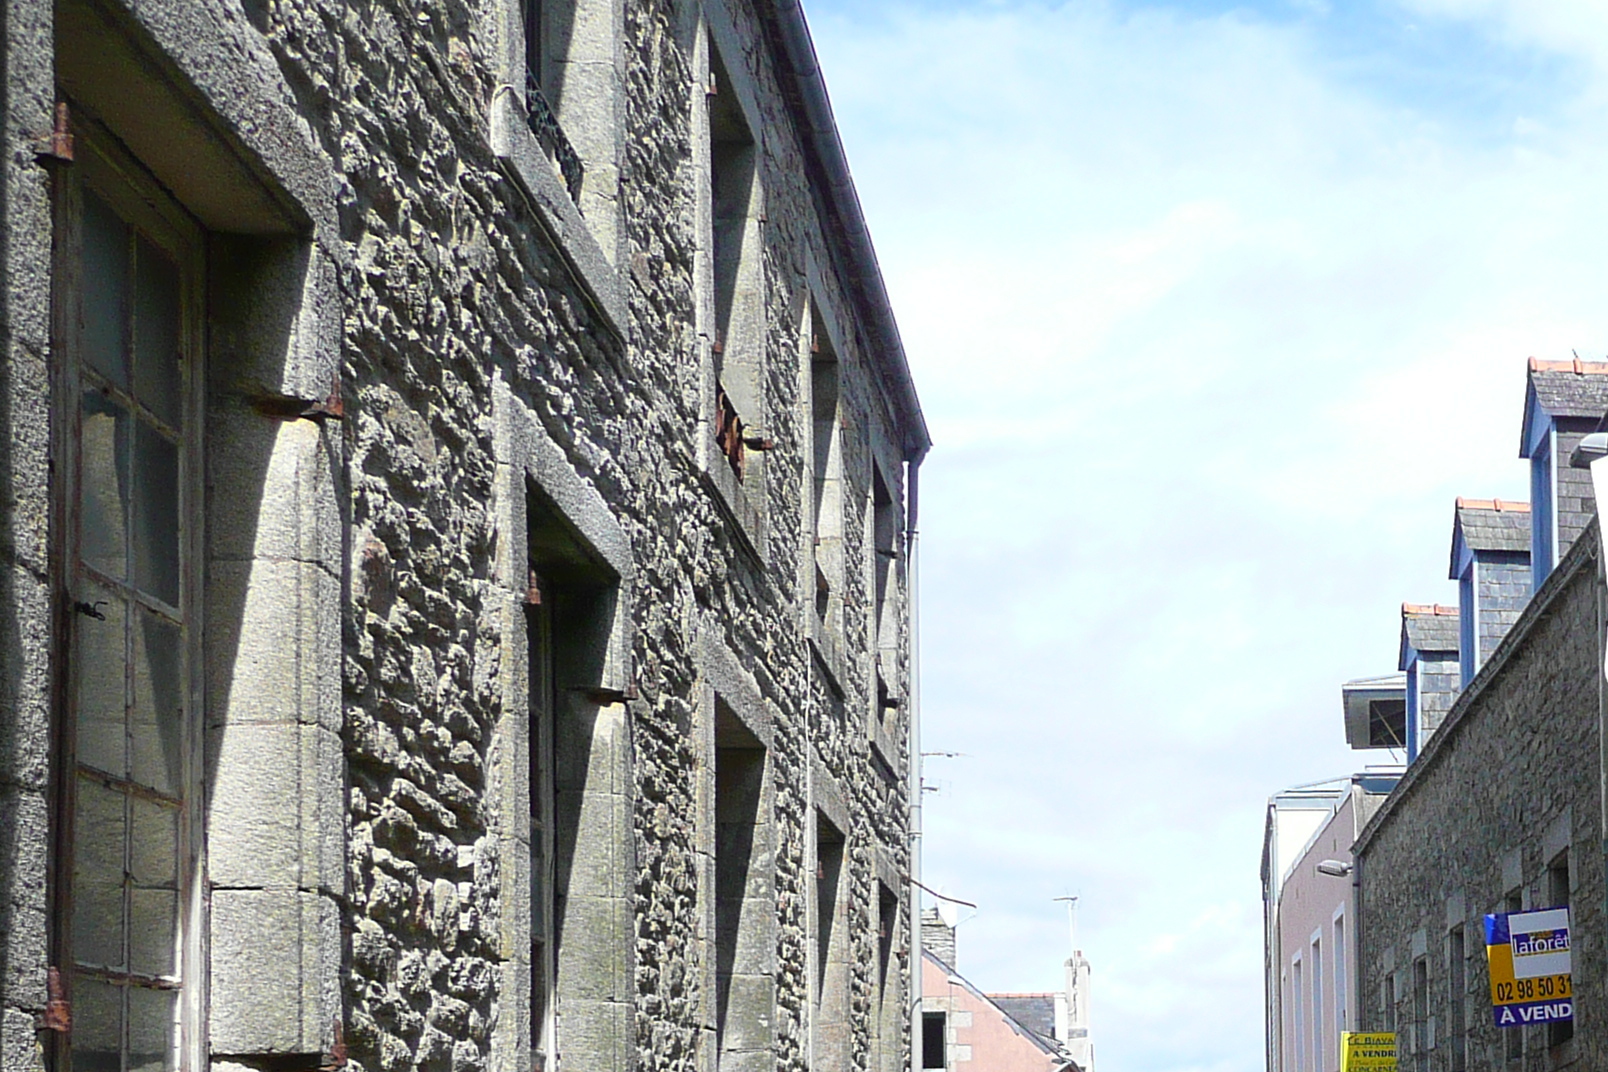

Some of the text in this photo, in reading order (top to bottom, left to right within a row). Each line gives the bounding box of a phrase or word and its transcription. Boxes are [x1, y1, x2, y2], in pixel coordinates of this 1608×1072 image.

[1513, 935, 1570, 954] laforêt
[1497, 982, 1514, 1001] 02
[1517, 979, 1534, 999] 98
[1538, 977, 1554, 996] 50
[1500, 1006, 1516, 1024] À
